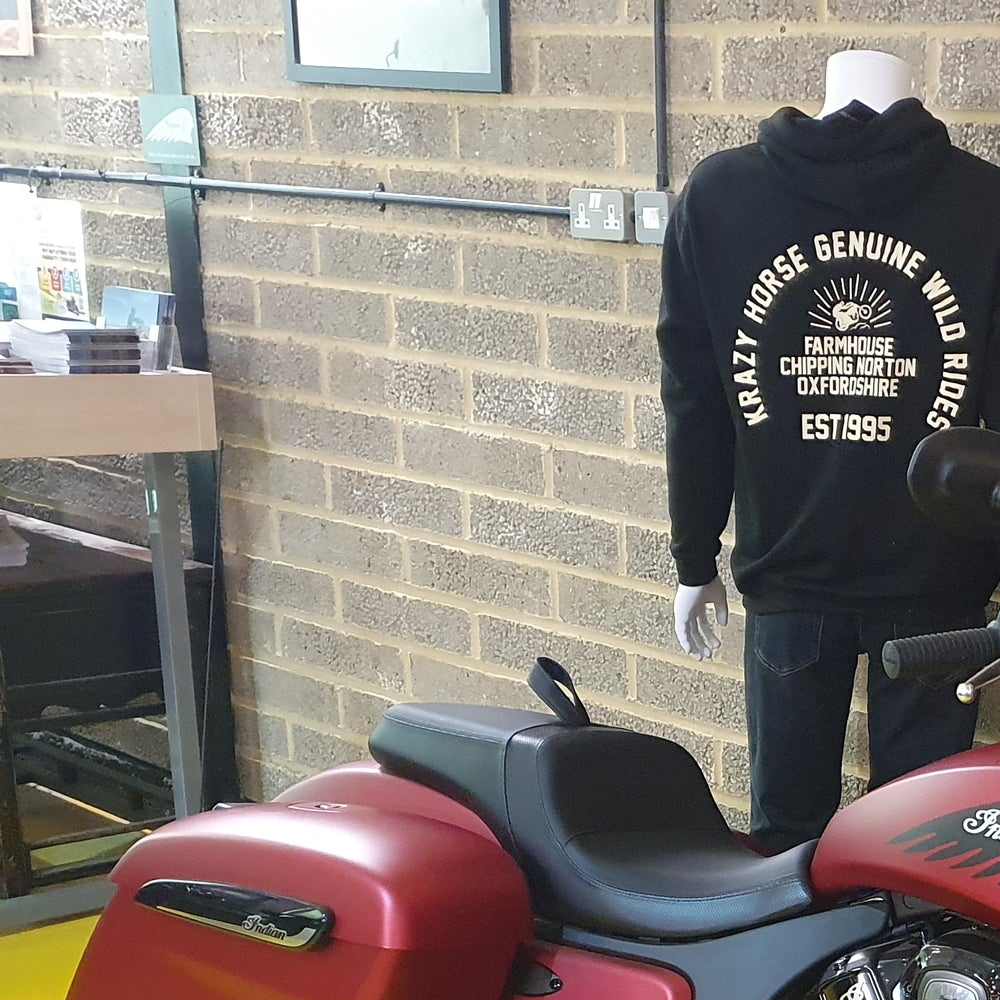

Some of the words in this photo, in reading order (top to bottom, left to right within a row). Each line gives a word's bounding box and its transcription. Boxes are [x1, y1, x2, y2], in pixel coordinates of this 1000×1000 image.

[813, 230, 926, 279] GENUINE
[743, 244, 810, 324] HORSE
[921, 270, 966, 342] WILD
[779, 356, 852, 376] CHIPPING
[856, 357, 917, 377] NORTON
[804, 336, 894, 357] FARMHOUSE
[732, 329, 769, 426] KRAZY
[797, 376, 899, 397] OXFORDSHIRE
[926, 353, 968, 430] RIDES
[241, 914, 287, 941] Indian
